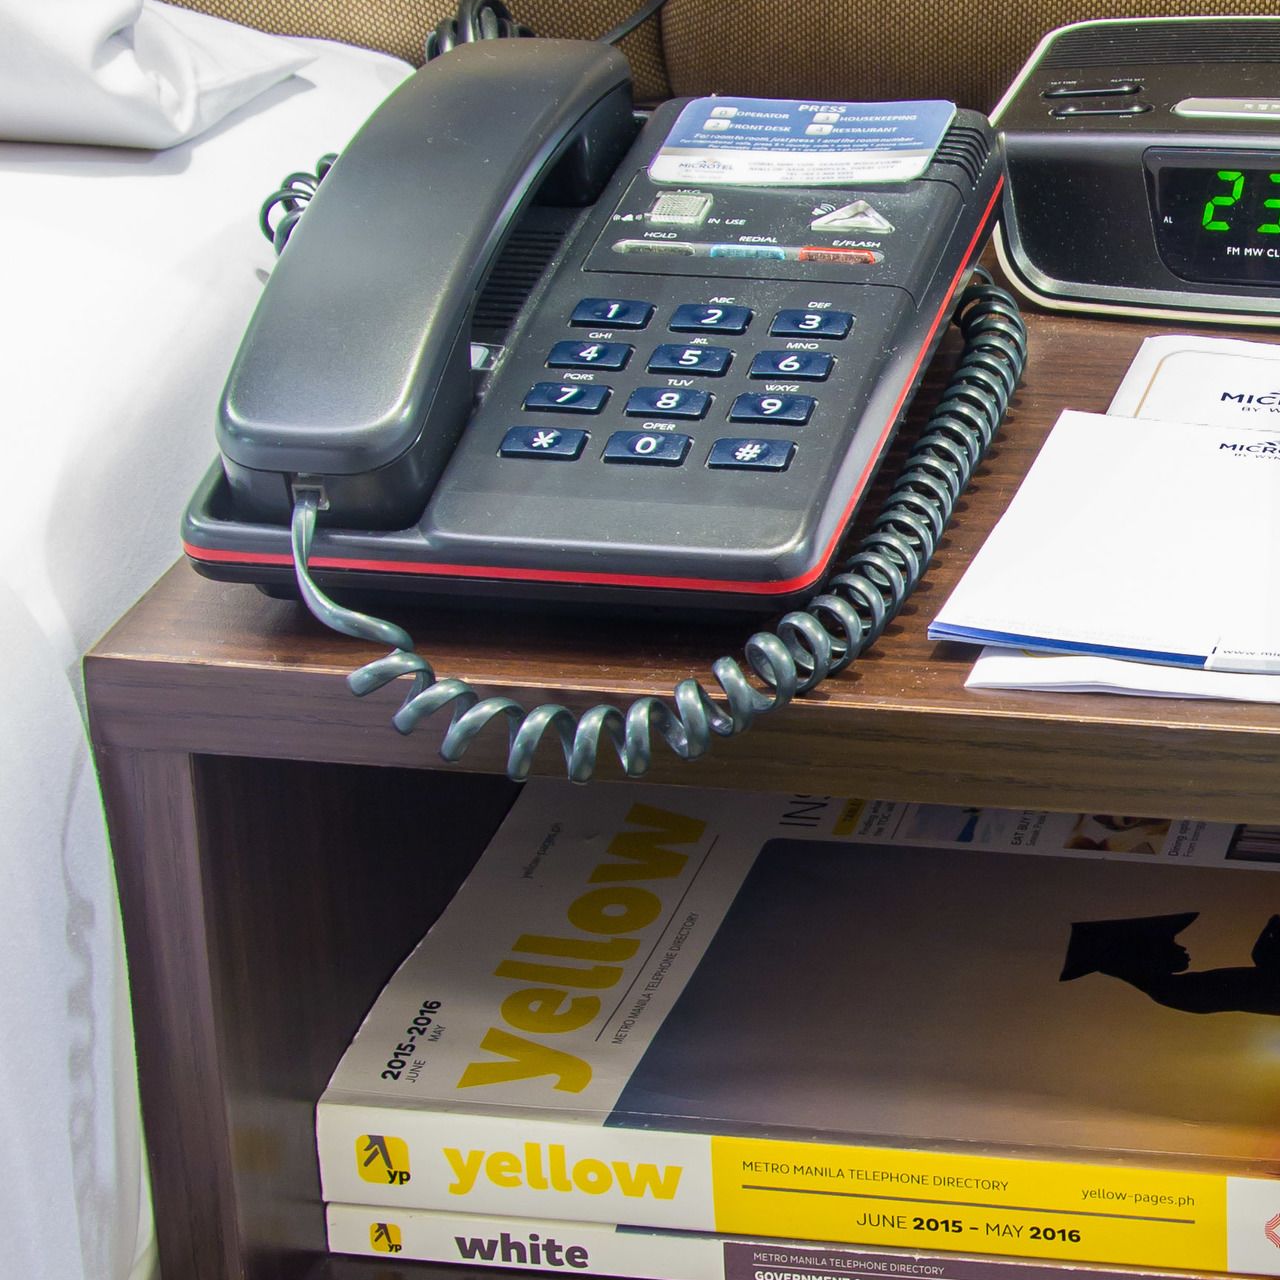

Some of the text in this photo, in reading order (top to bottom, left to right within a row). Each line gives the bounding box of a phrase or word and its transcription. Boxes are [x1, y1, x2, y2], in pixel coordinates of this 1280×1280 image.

[736, 111, 790, 119] OPERATOR
[798, 104, 847, 113] PRESS
[729, 123, 764, 131] FRONT
[764, 124, 792, 132] DESK
[725, 218, 746, 226] USE
[1163, 216, 1173, 224] AL
[644, 231, 881, 248] HOLD REDIAL E/FLASH
[1226, 246, 1240, 256] FM
[1244, 247, 1264, 257] MW
[456, 803, 708, 1094] yellow
[611, 911, 700, 1045] METRO MANILA TELEPHONE DIRECTORY
[381, 1000, 441, 1081] 2015-2016
[405, 1024, 446, 1083] JUNE MAY
[386, 1169, 411, 1185] yp
[443, 1142, 684, 1200] yellow
[742, 1160, 1009, 1192] METRO MANILA TELEPHONE DIRECTORY
[1081, 1187, 1196, 1208] yellow-pages.ph
[856, 1212, 908, 1230] JUNE
[912, 1217, 963, 1234] 2015
[985, 1223, 1025, 1238] MAY
[1029, 1226, 1081, 1243] 2016
[387, 1242, 402, 1254] yp
[454, 1232, 590, 1269] white
[753, 1252, 945, 1275] METRO MANILA TELEPHONE DIRECTORY
